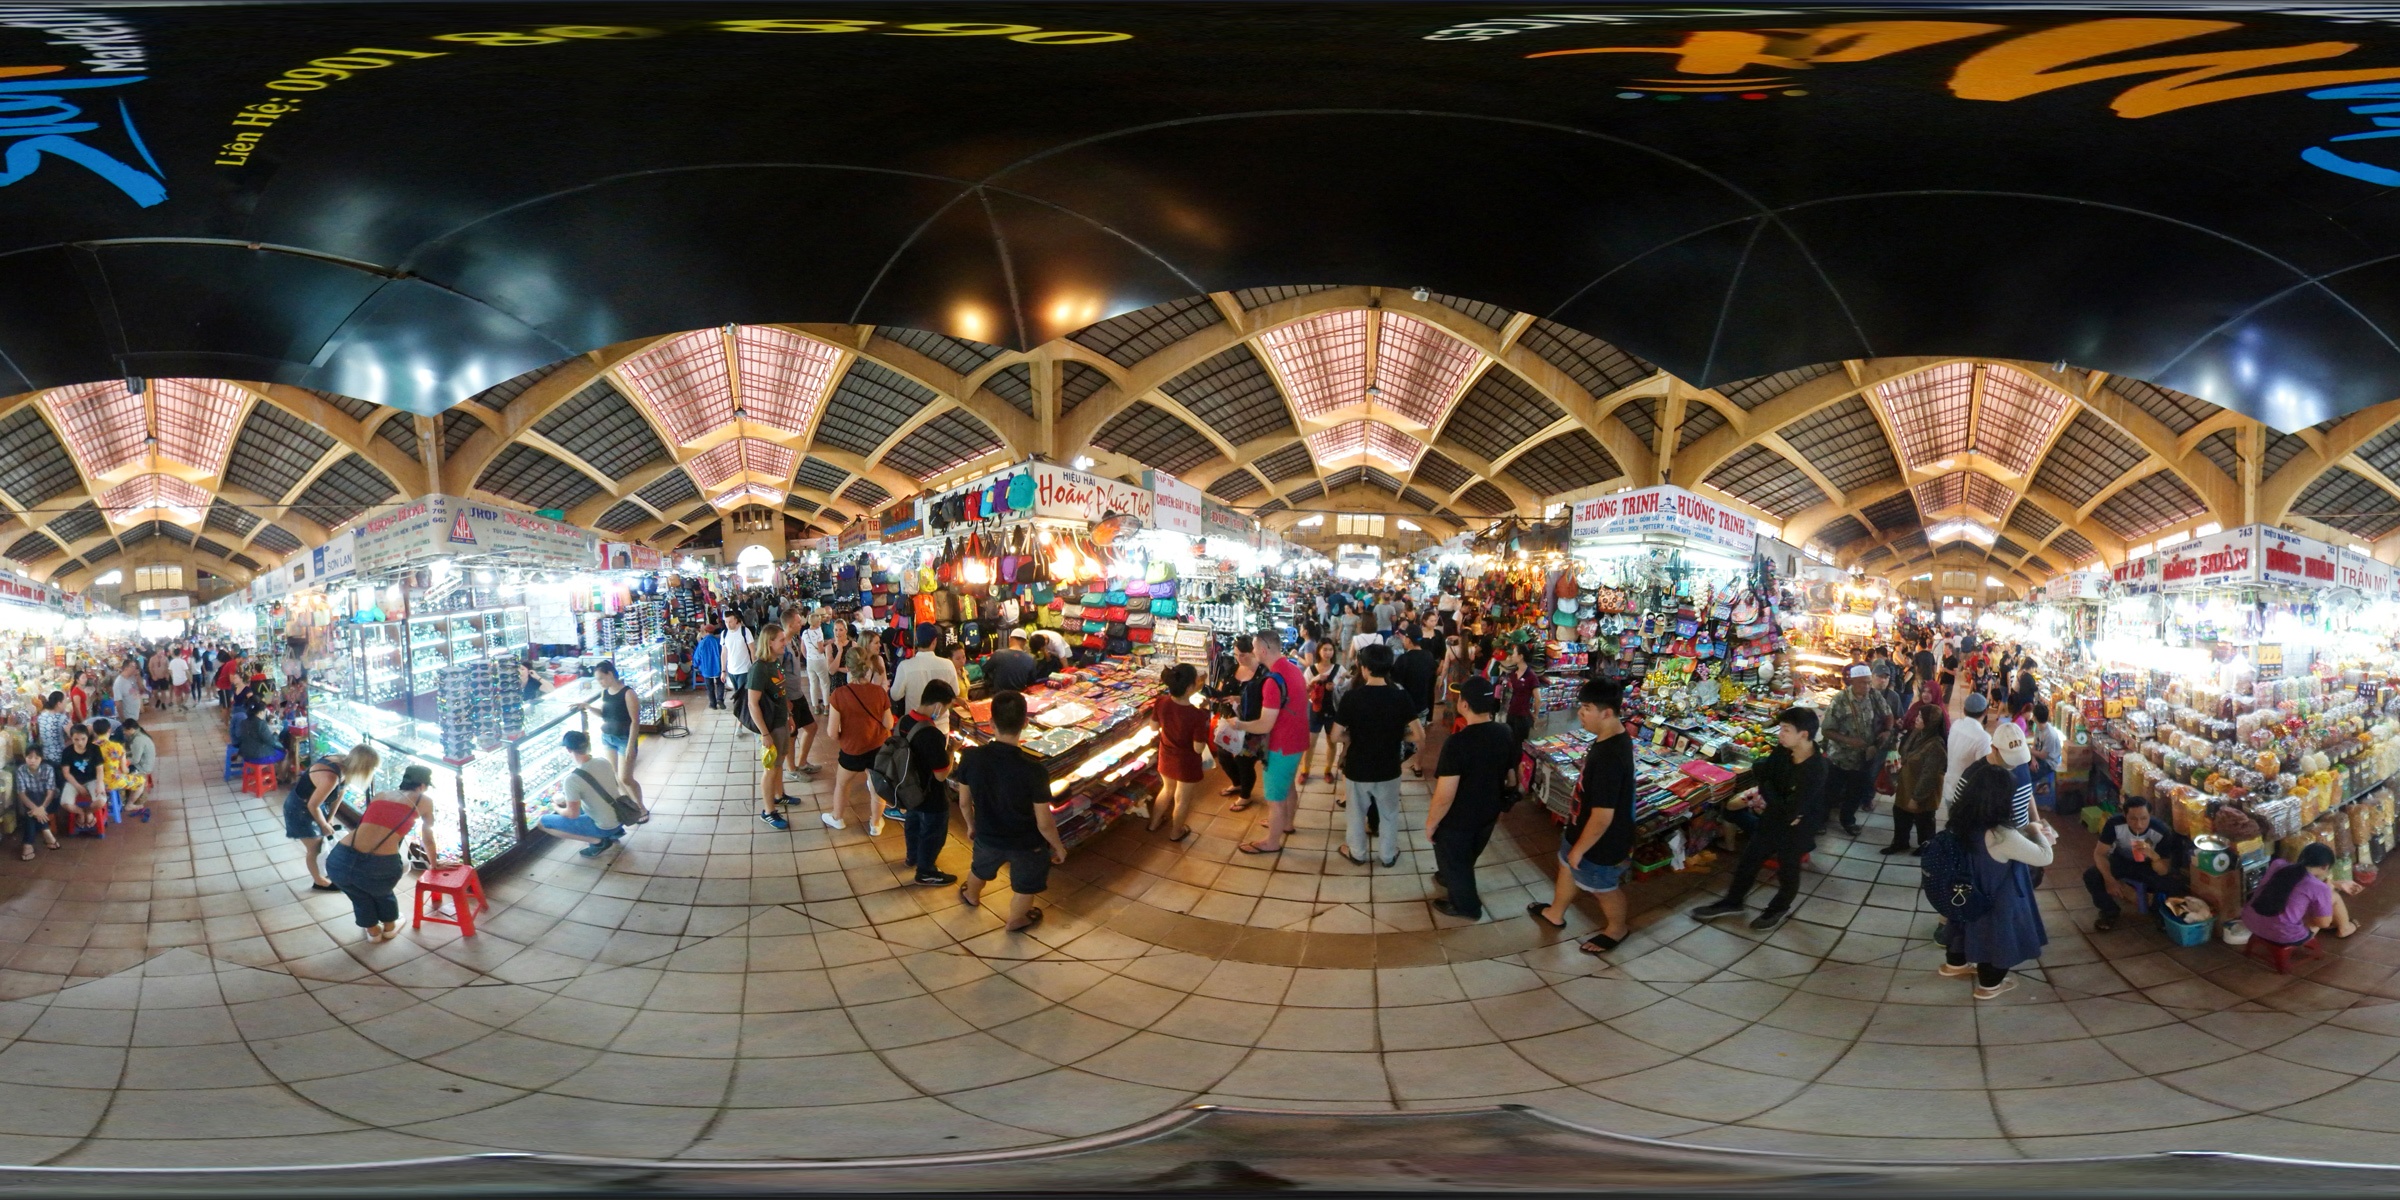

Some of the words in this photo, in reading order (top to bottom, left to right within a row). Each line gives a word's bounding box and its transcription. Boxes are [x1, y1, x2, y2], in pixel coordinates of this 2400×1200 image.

[265, 47, 450, 92] 0901
[234, 96, 302, 130] Hệ:
[215, 127, 264, 168] Liên
[1062, 471, 1081, 483] HIỆU
[1038, 473, 1093, 518] Hoàng
[1096, 483, 1129, 515] Phúc
[1585, 498, 1617, 521] HƯƠNG
[1621, 492, 1660, 516] TRINH
[470, 507, 498, 521] SHOP
[503, 511, 550, 533] Ngọc
[1575, 513, 1583, 522] 796
[1678, 494, 1715, 525] HƯƠNG
[1718, 510, 1746, 535] TRINH
[1643, 523, 1664, 531] POTTERY
[2238, 527, 2253, 538] 743
[2277, 533, 2290, 543] BÁNH
[340, 553, 352, 567] LAN
[2341, 564, 2372, 589] TRẦN
